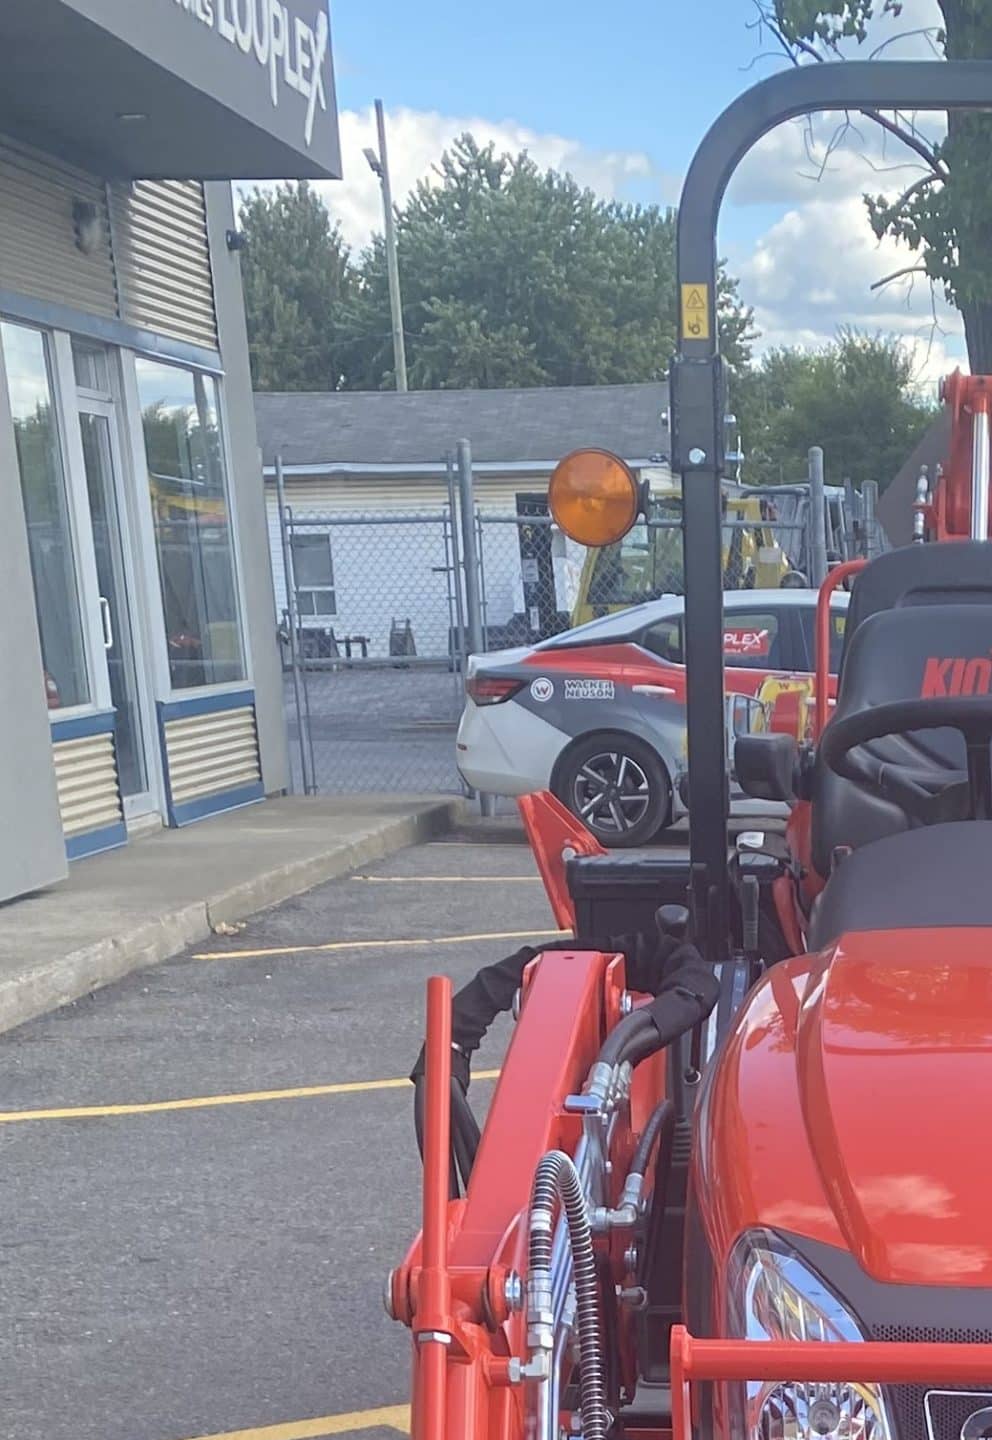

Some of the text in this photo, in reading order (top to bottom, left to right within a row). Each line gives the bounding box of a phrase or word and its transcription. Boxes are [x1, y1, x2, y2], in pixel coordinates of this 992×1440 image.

[723, 629, 768, 650] PLEX
[565, 680, 613, 689] WACKER
[565, 689, 613, 698] NEUSON
